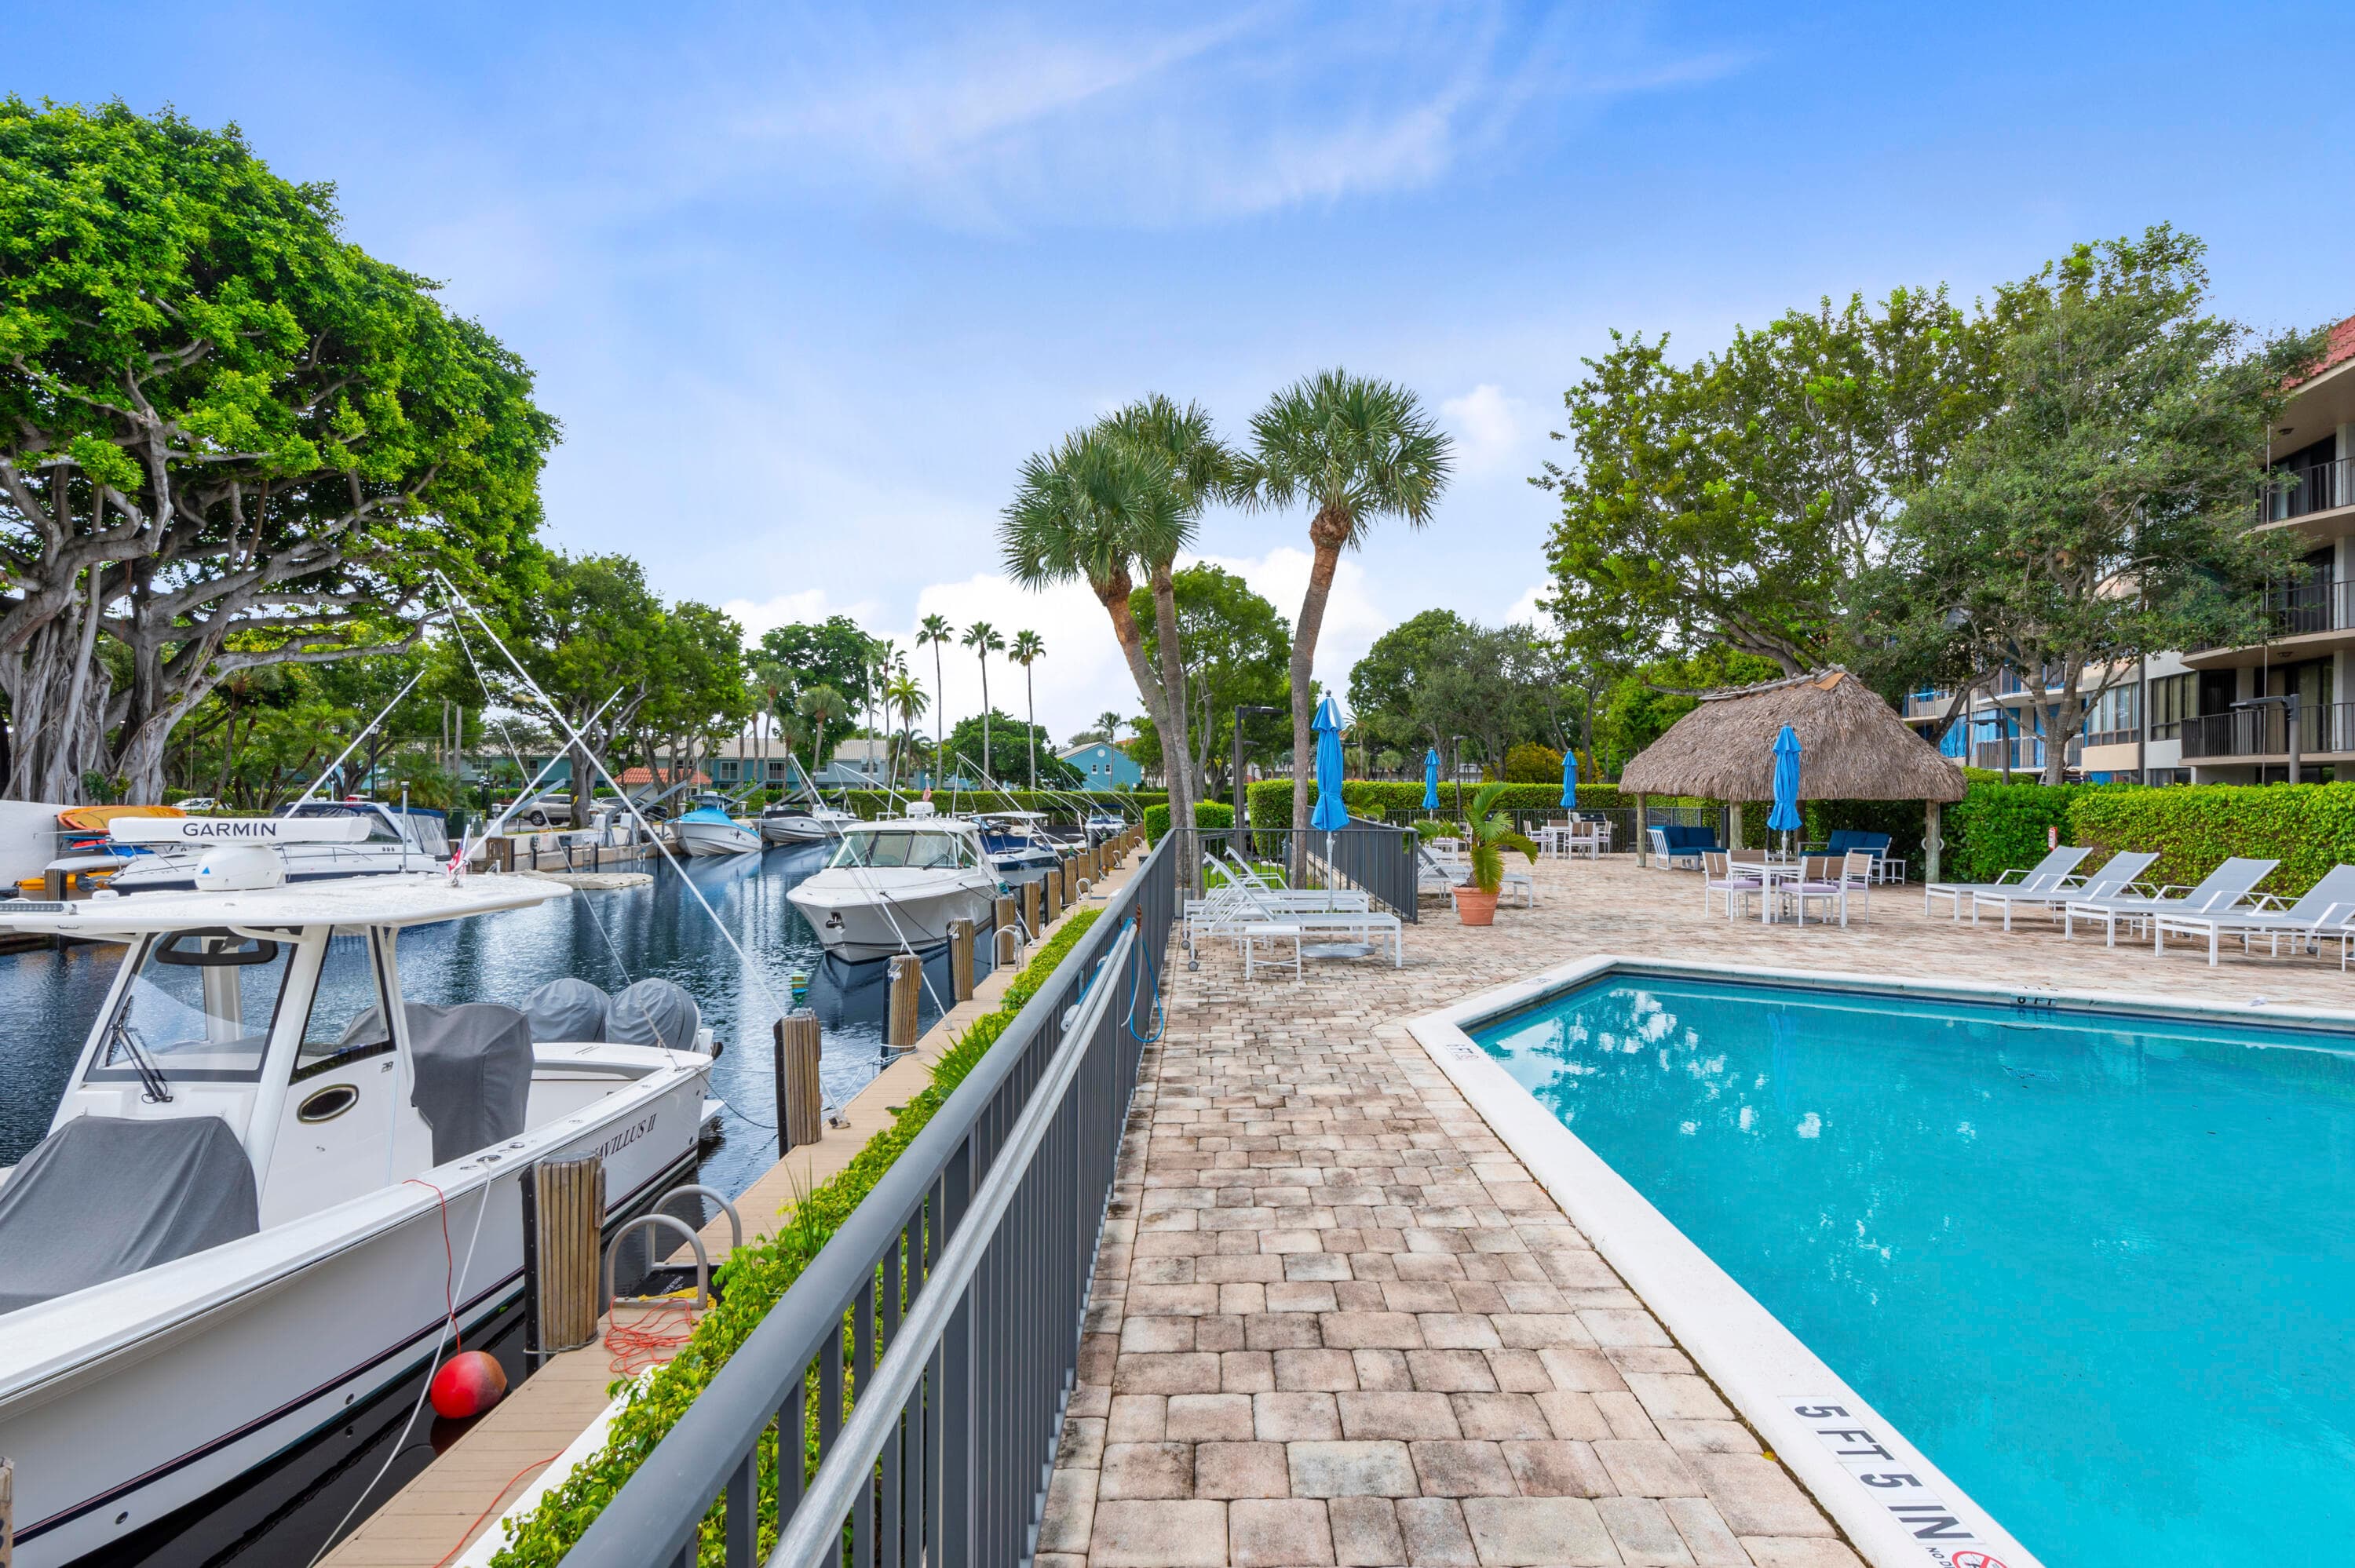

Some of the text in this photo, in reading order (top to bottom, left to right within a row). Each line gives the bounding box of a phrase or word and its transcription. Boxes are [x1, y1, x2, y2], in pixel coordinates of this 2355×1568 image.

[183, 822, 276, 837] GARMIN
[2017, 996, 2026, 1005] 6
[595, 1119, 647, 1160] AVILLUS
[1795, 1406, 1975, 1539] 5 FT 5 IN
[1926, 1547, 1944, 1559] NO
